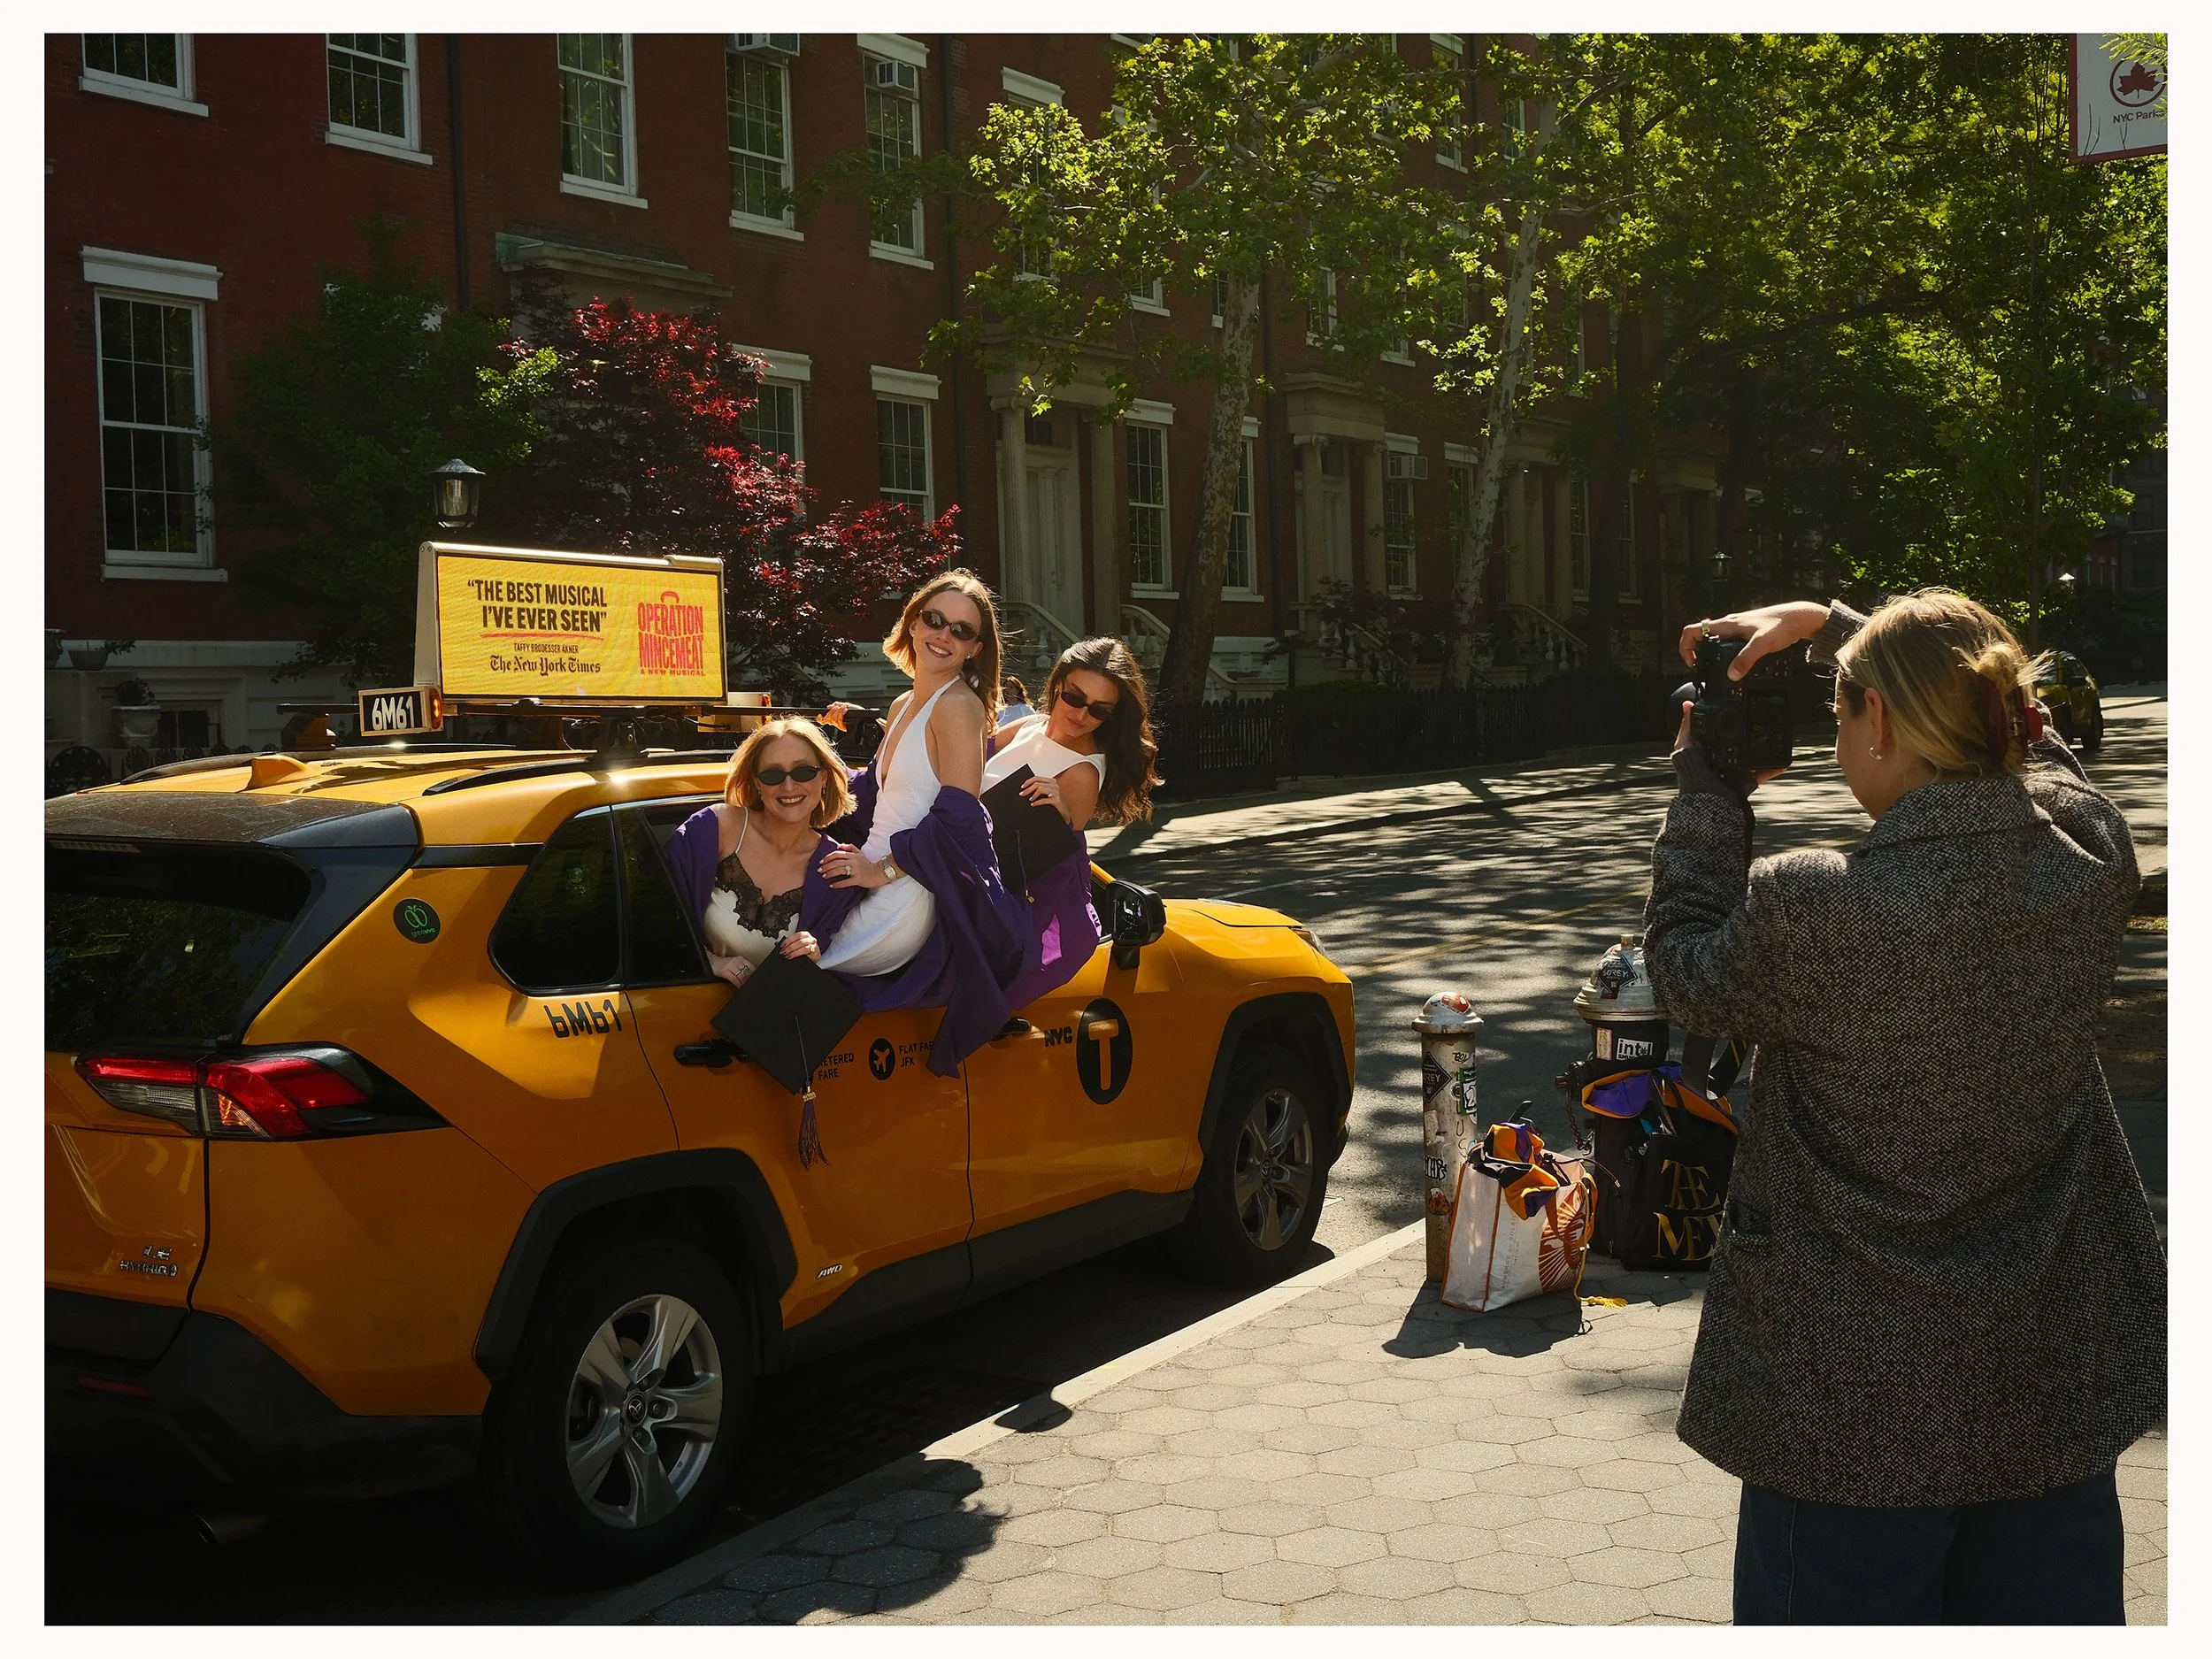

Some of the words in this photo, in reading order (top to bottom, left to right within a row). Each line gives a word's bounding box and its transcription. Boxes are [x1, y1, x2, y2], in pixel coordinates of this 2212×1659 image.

[2113, 112, 2134, 124] NYC
[2136, 109, 2165, 120] Parks
[506, 581, 542, 604] BEST
[545, 583, 608, 608] MUSICAL
[517, 607, 558, 631] EVER
[638, 602, 704, 637] OPERATION
[514, 642, 531, 652] TAFFY
[638, 631, 704, 670] MINCEMEAT
[490, 654, 512, 672] The
[513, 655, 538, 673] New
[539, 657, 566, 677] York
[568, 657, 602, 673] Times
[372, 695, 415, 731] 6M61
[544, 999, 623, 1039] 6M61
[898, 1043, 918, 1055] FLAT
[1044, 1026, 1073, 1048] NYC
[1087, 1018, 1119, 1091] T
[900, 1056, 916, 1068] JFK
[818, 1068, 839, 1080] FARE
[816, 1263, 843, 1279] AWD
